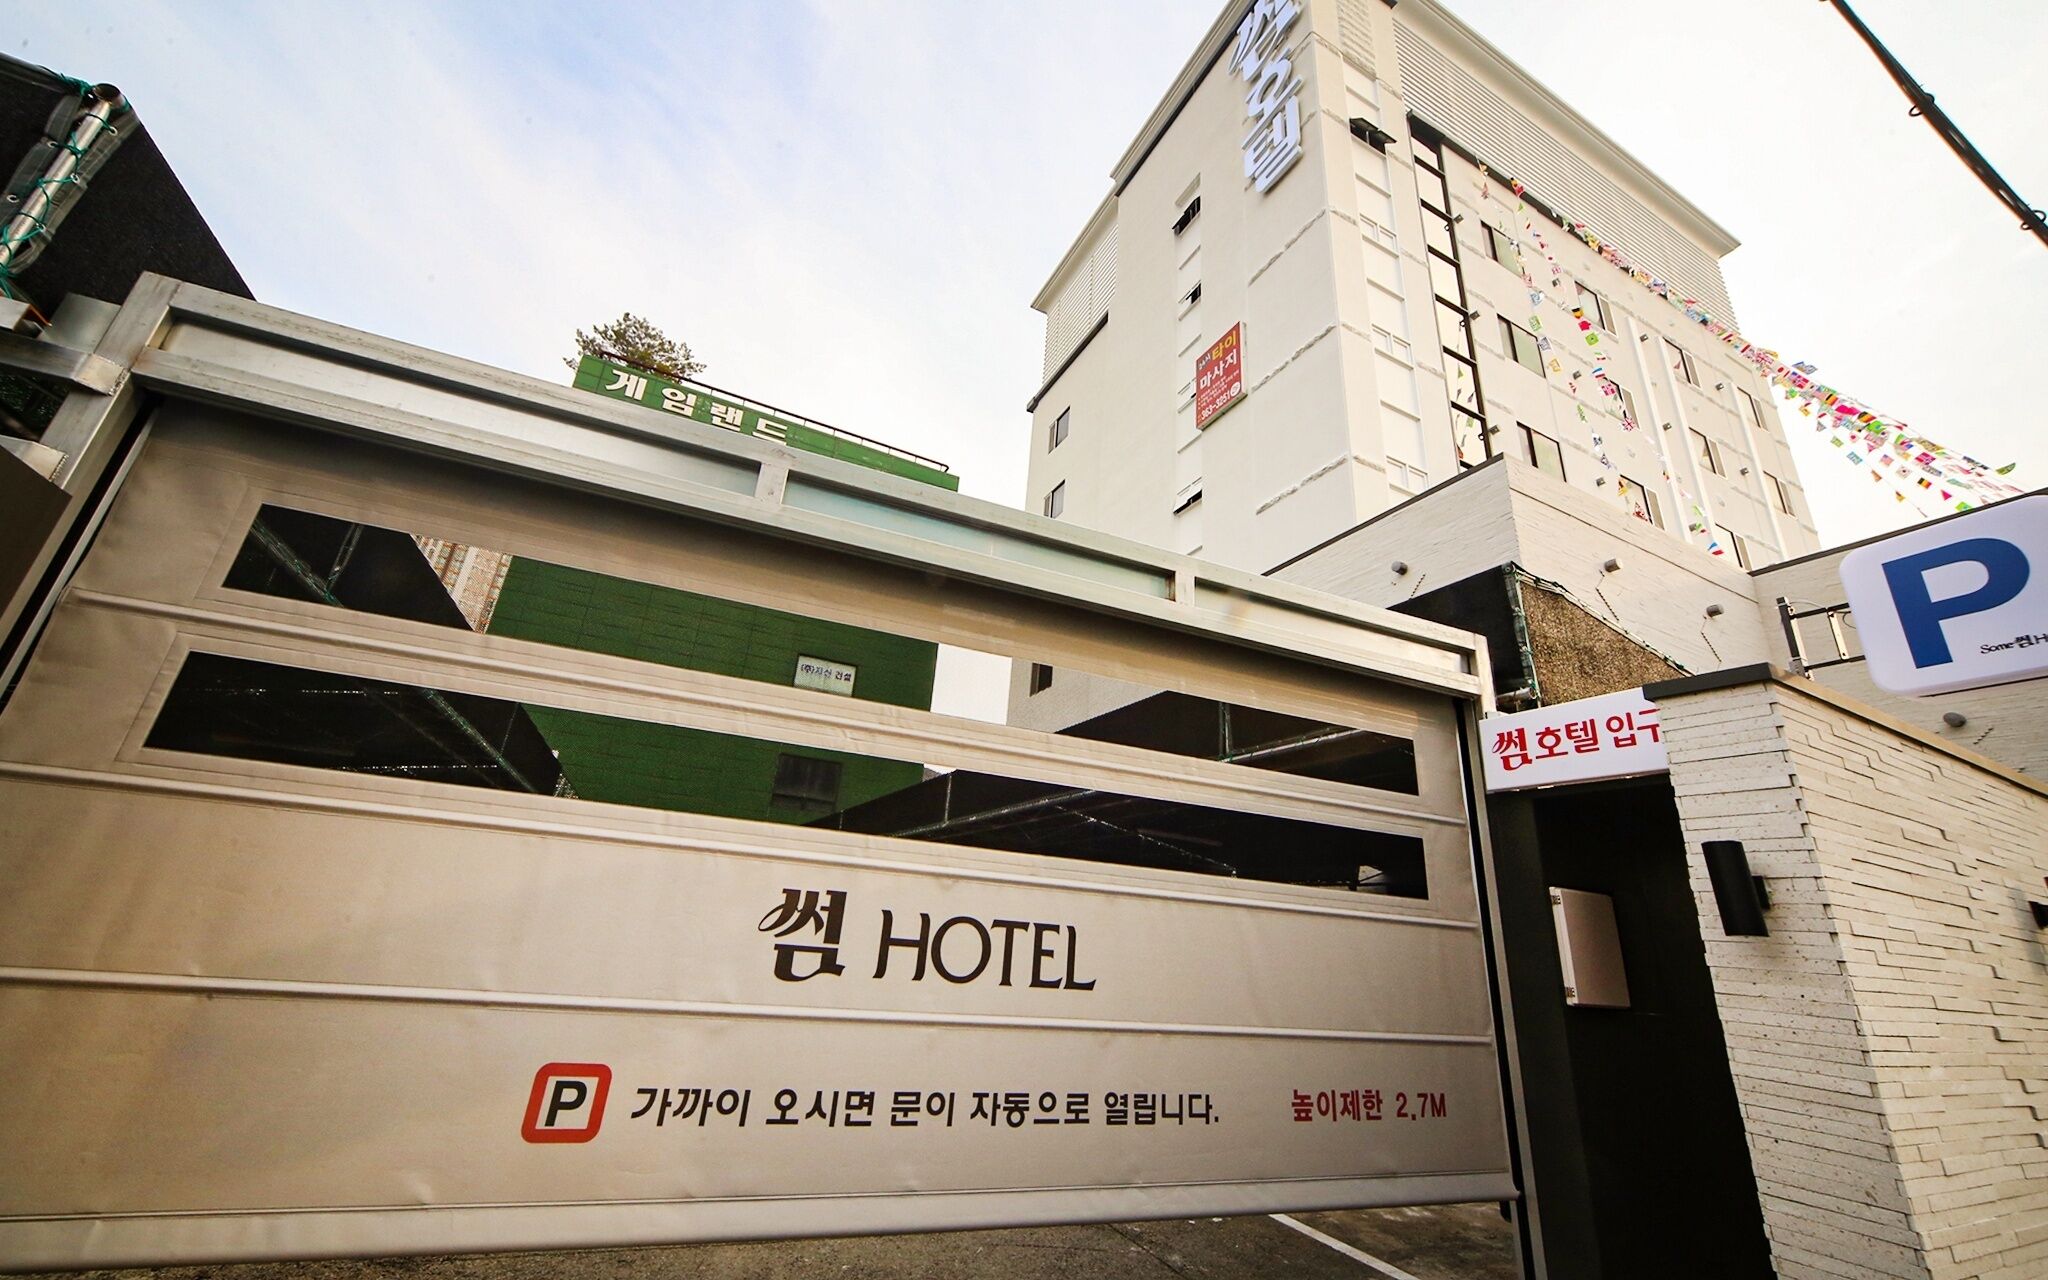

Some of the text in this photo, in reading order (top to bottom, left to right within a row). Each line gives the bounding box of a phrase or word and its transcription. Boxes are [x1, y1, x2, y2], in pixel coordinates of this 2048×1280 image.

[1200, 349, 1237, 389] 마사지
[1212, 330, 1237, 360] 타이
[605, 369, 788, 446] 게임랜드
[1881, 538, 2030, 669] P
[758, 888, 1096, 991] 썸 HOTEL
[544, 1080, 1220, 1128] P 가까이 오시면 문이 자동으로 열립니다.
[1291, 1089, 1447, 1122] 높이제한 2.7M
